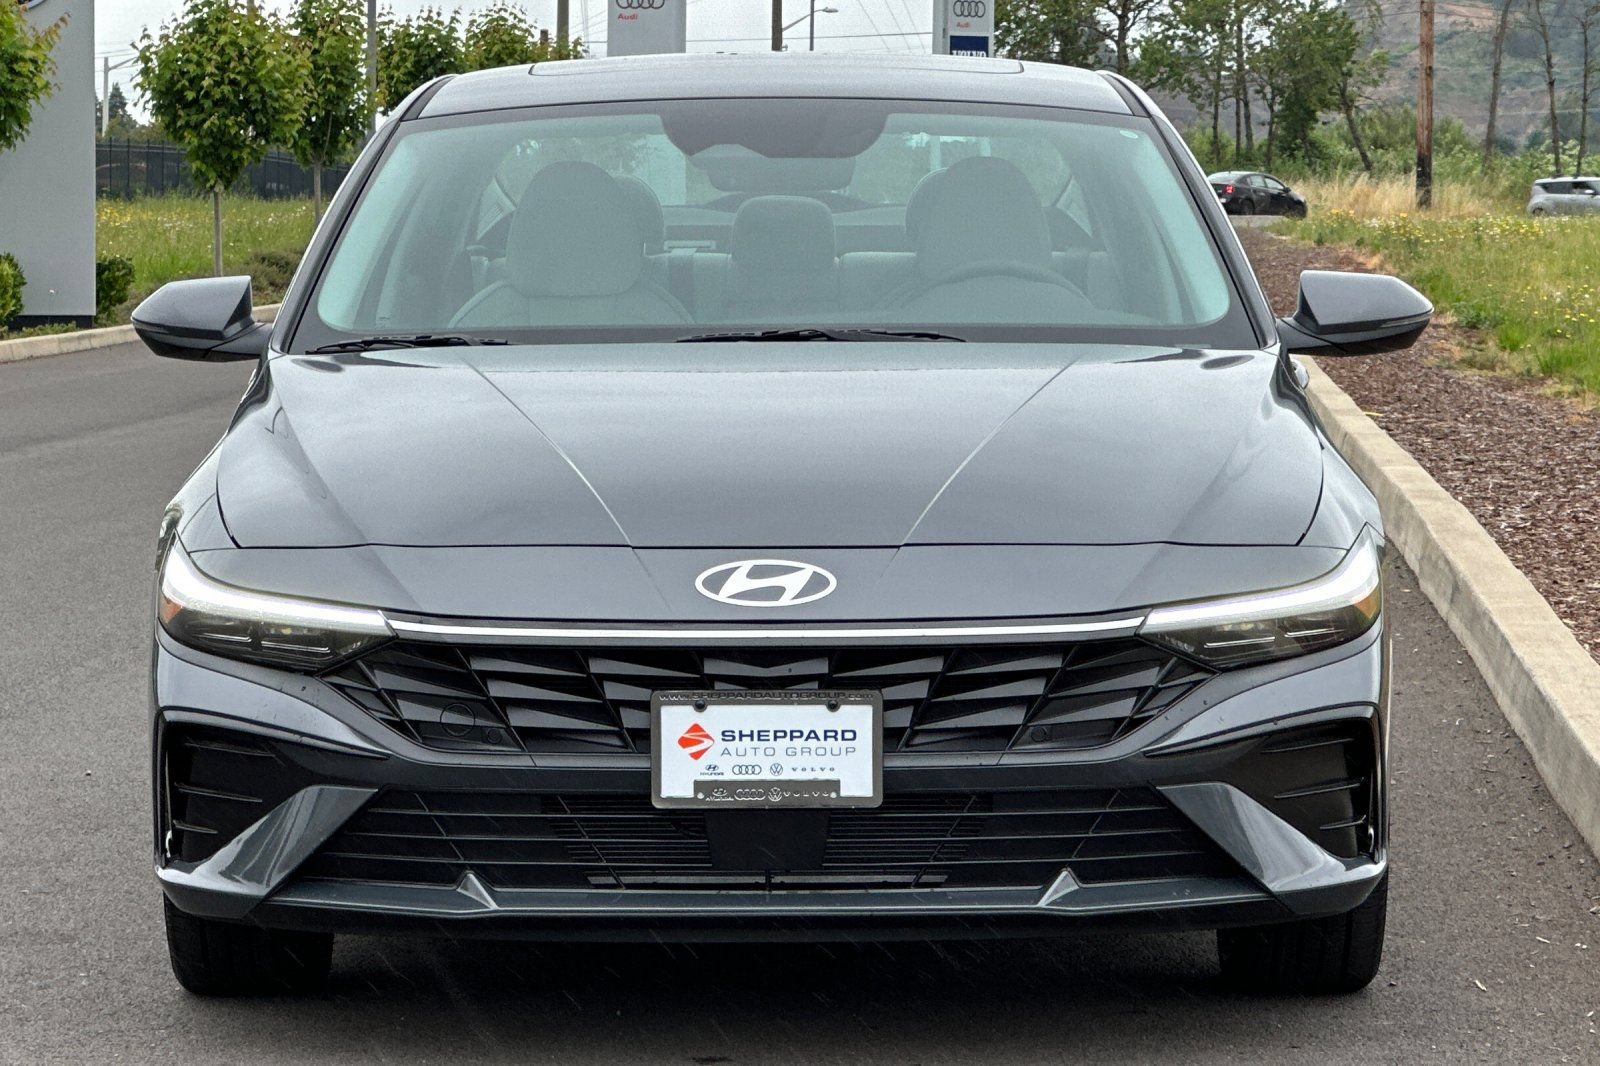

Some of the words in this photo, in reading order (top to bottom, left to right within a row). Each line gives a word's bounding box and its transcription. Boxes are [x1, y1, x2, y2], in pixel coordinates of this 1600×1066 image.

[721, 729, 857, 742] SHEPPARD
[720, 747, 776, 757] AUTO
[785, 747, 856, 757] GROUP
